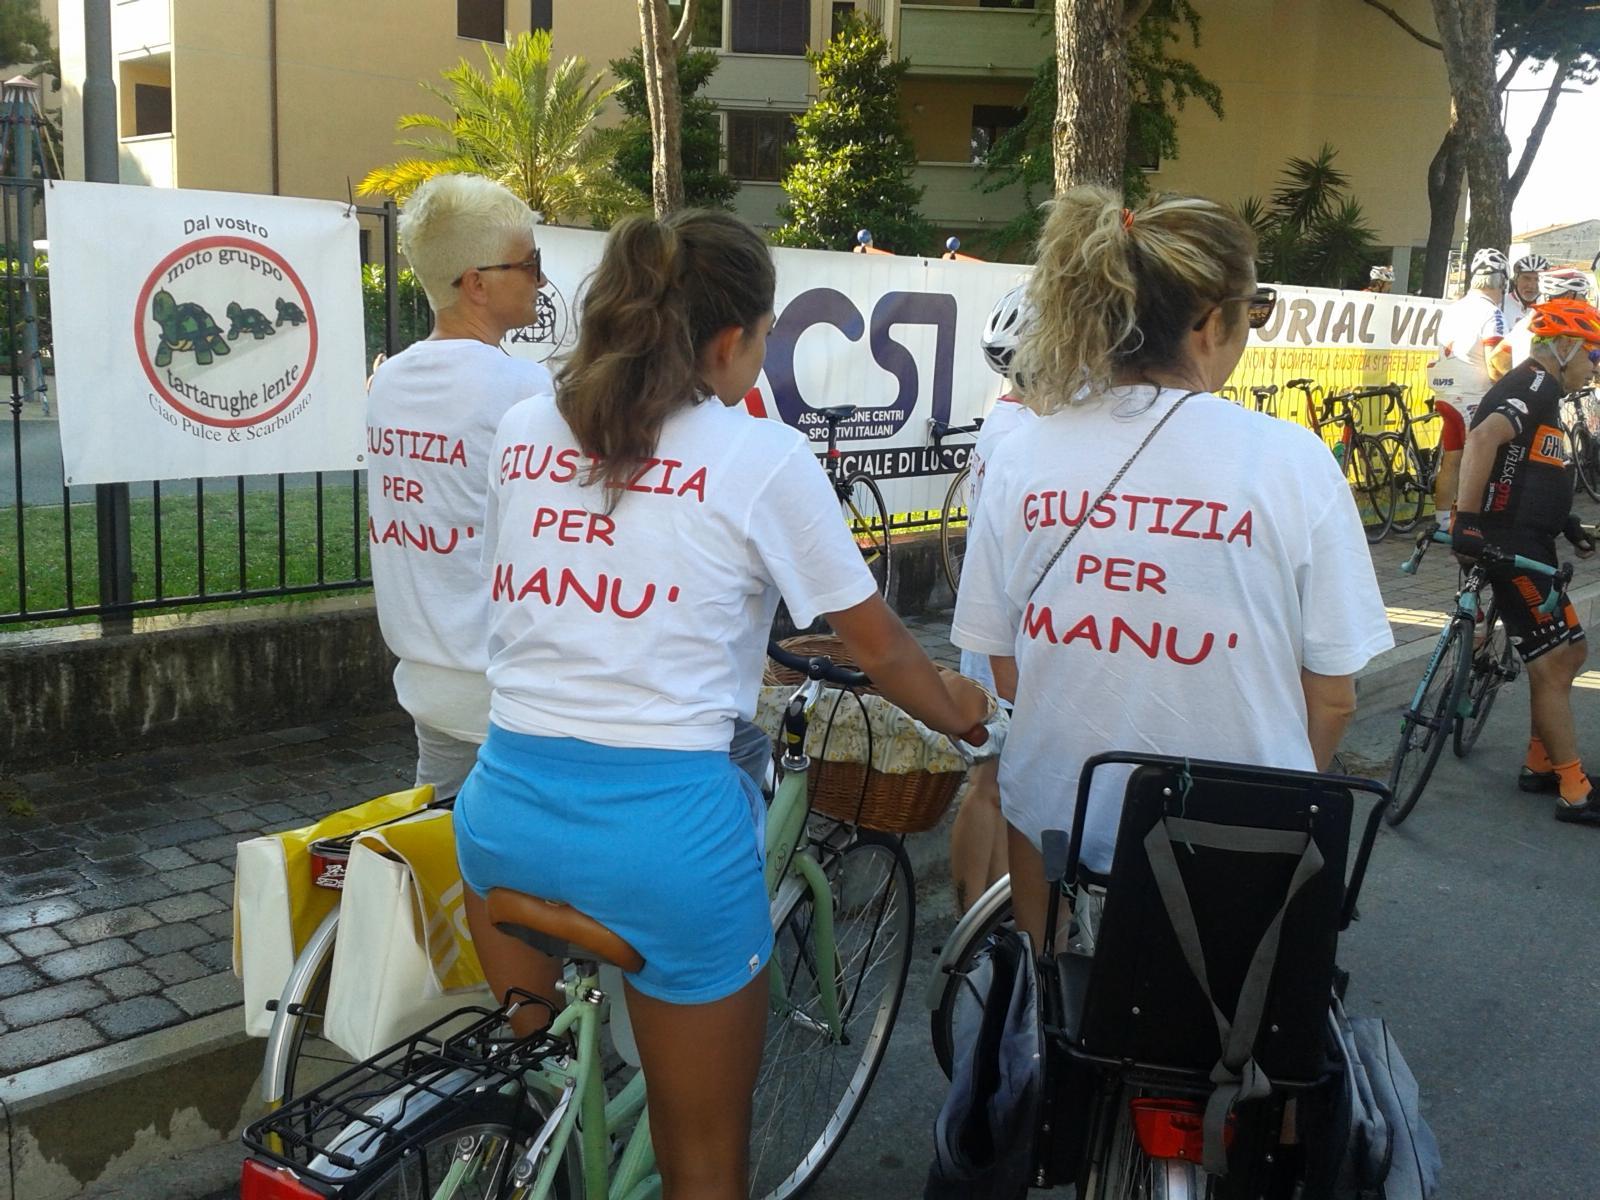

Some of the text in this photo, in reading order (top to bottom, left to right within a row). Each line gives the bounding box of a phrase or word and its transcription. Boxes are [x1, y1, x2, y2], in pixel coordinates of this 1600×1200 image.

[184, 215, 269, 238] Dal vostro
[167, 249, 282, 283] moto gruppo
[1256, 297, 1376, 346] ORIAL
[745, 287, 957, 441] CSI
[1244, 351, 1266, 369] NON
[167, 365, 298, 417] tartarughe lente
[1433, 378, 1454, 386] AVIS
[148, 393, 178, 426] Ciao
[182, 418, 222, 441] Pulce
[227, 428, 241, 442] &
[798, 410, 904, 424] ASSOZIONE CENTRI
[809, 424, 894, 439] SPOTIVI ITALIANI
[368, 427, 467, 468] USTIZIA
[899, 451, 915, 474] DI
[383, 475, 424, 504] PER
[500, 444, 708, 503] GIUSTZIA
[532, 507, 617, 547] PER
[1023, 490, 1253, 548] GIUSTIZIA
[493, 563, 680, 620] MANU'
[1075, 554, 1167, 595] PER
[1022, 602, 1238, 666] MANU'
